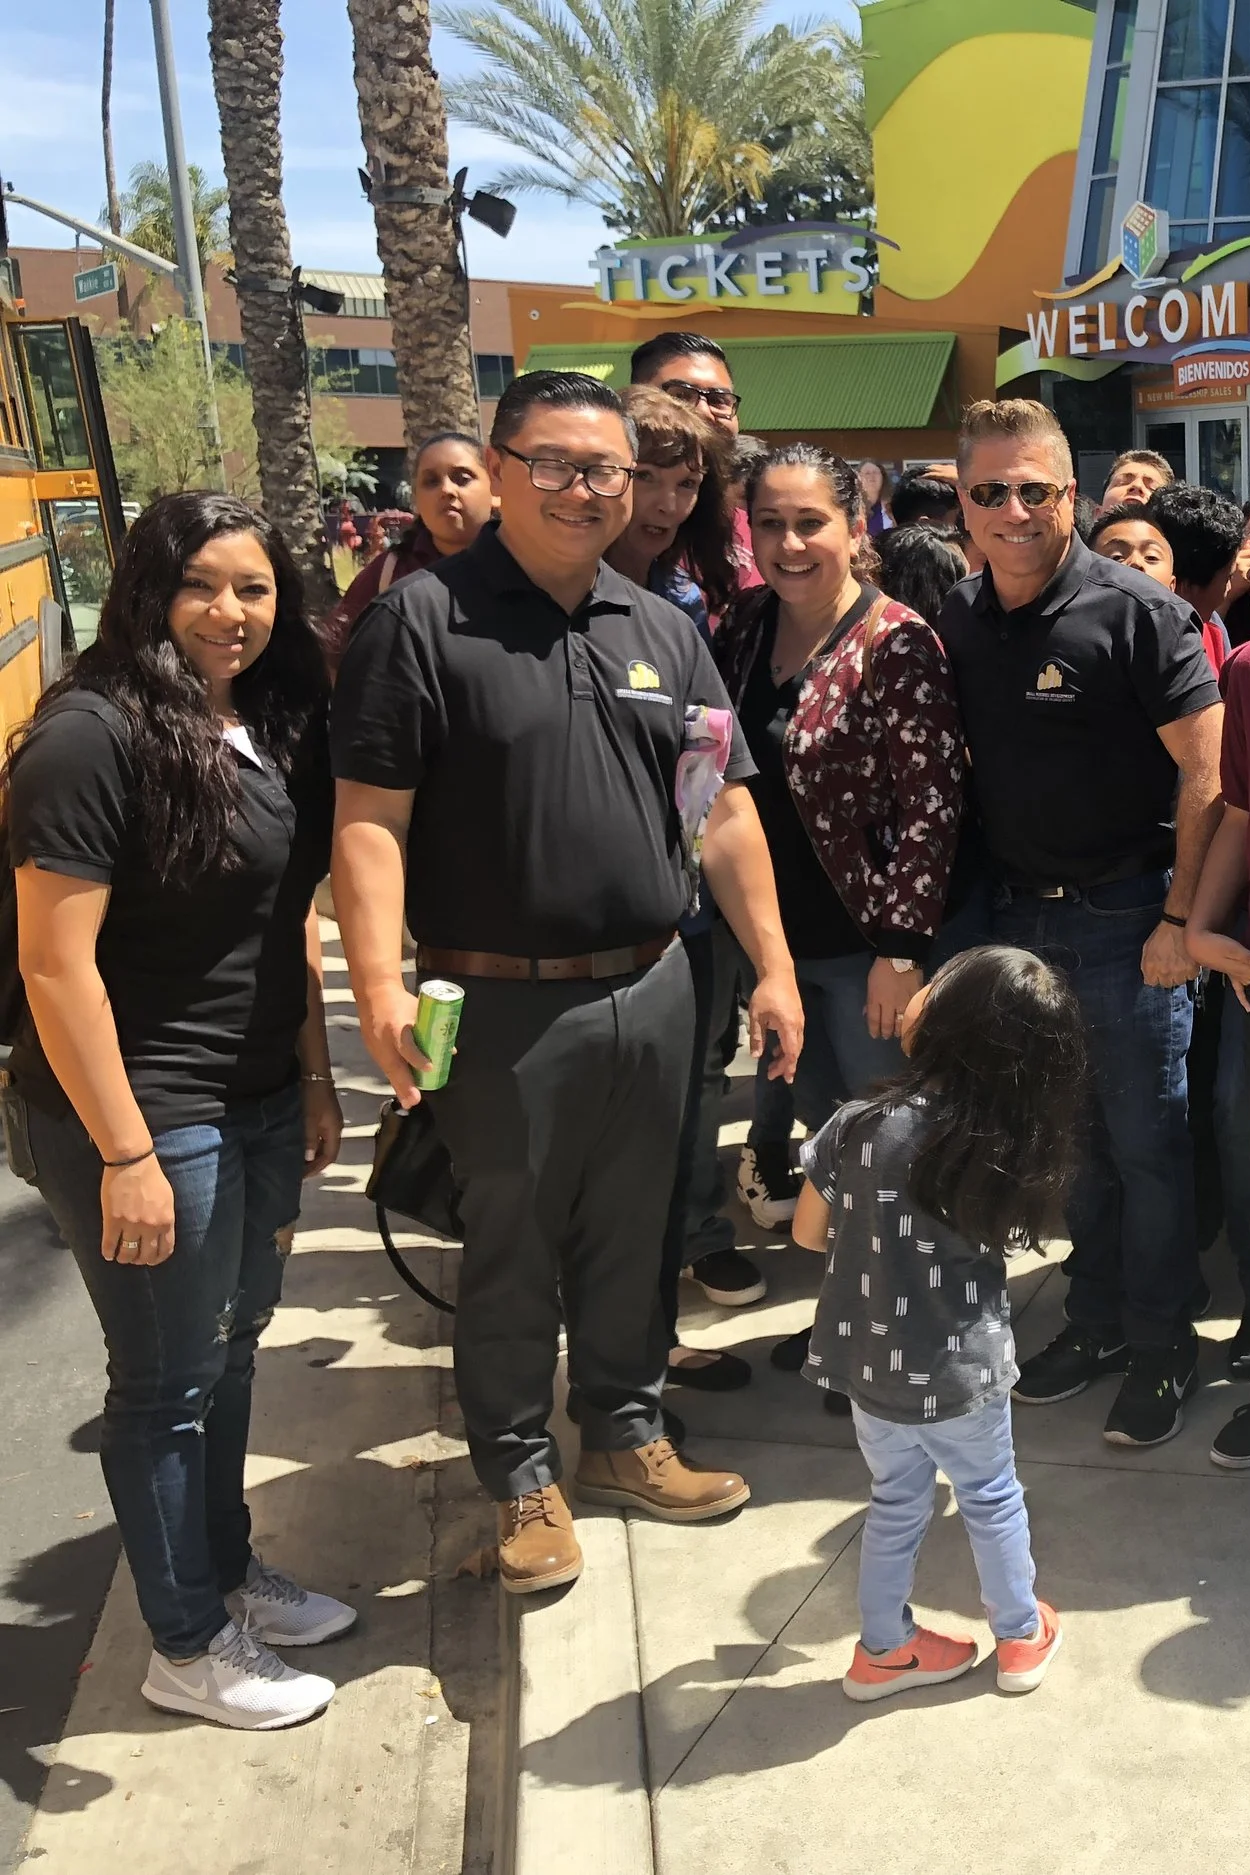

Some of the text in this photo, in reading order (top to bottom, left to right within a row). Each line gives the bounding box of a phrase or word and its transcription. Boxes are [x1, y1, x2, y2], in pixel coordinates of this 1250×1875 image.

[589, 247, 869, 301] TICKETS
[1178, 361, 1250, 386] BIENVENIDOS
[1147, 386, 1232, 402] NEW MESHIP SALES
